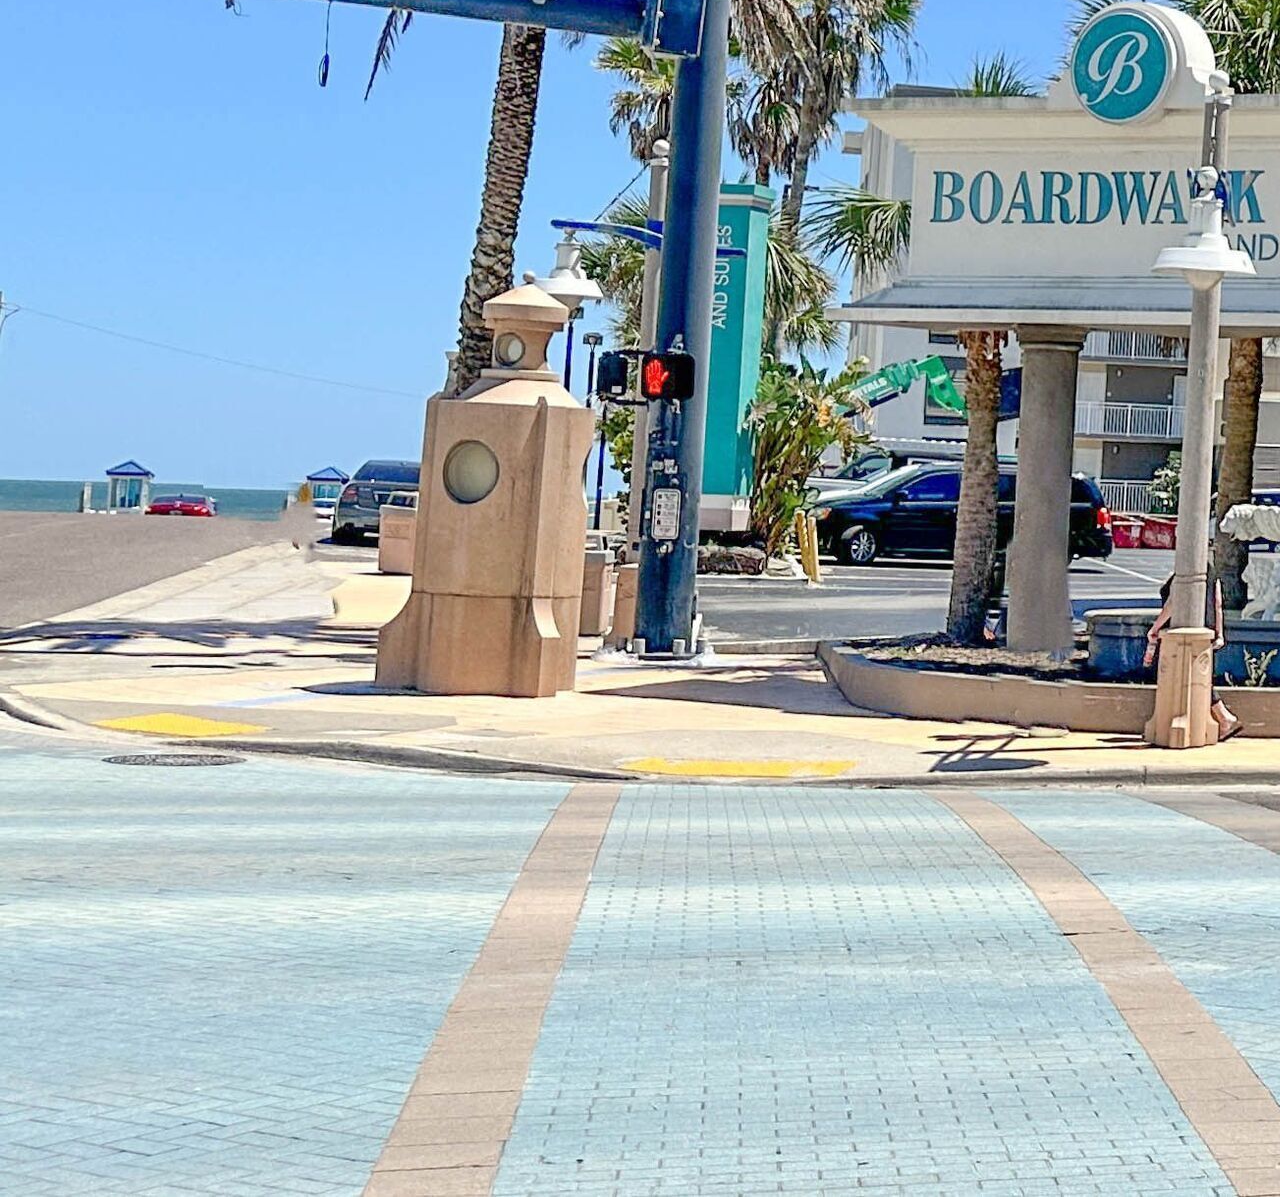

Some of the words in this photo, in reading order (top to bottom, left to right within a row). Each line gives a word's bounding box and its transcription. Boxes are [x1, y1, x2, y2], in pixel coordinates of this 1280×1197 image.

[1080, 31, 1149, 106] B
[929, 169, 1265, 226] BOARDWAK
[714, 225, 733, 286] SUIES
[711, 292, 728, 329] AND
